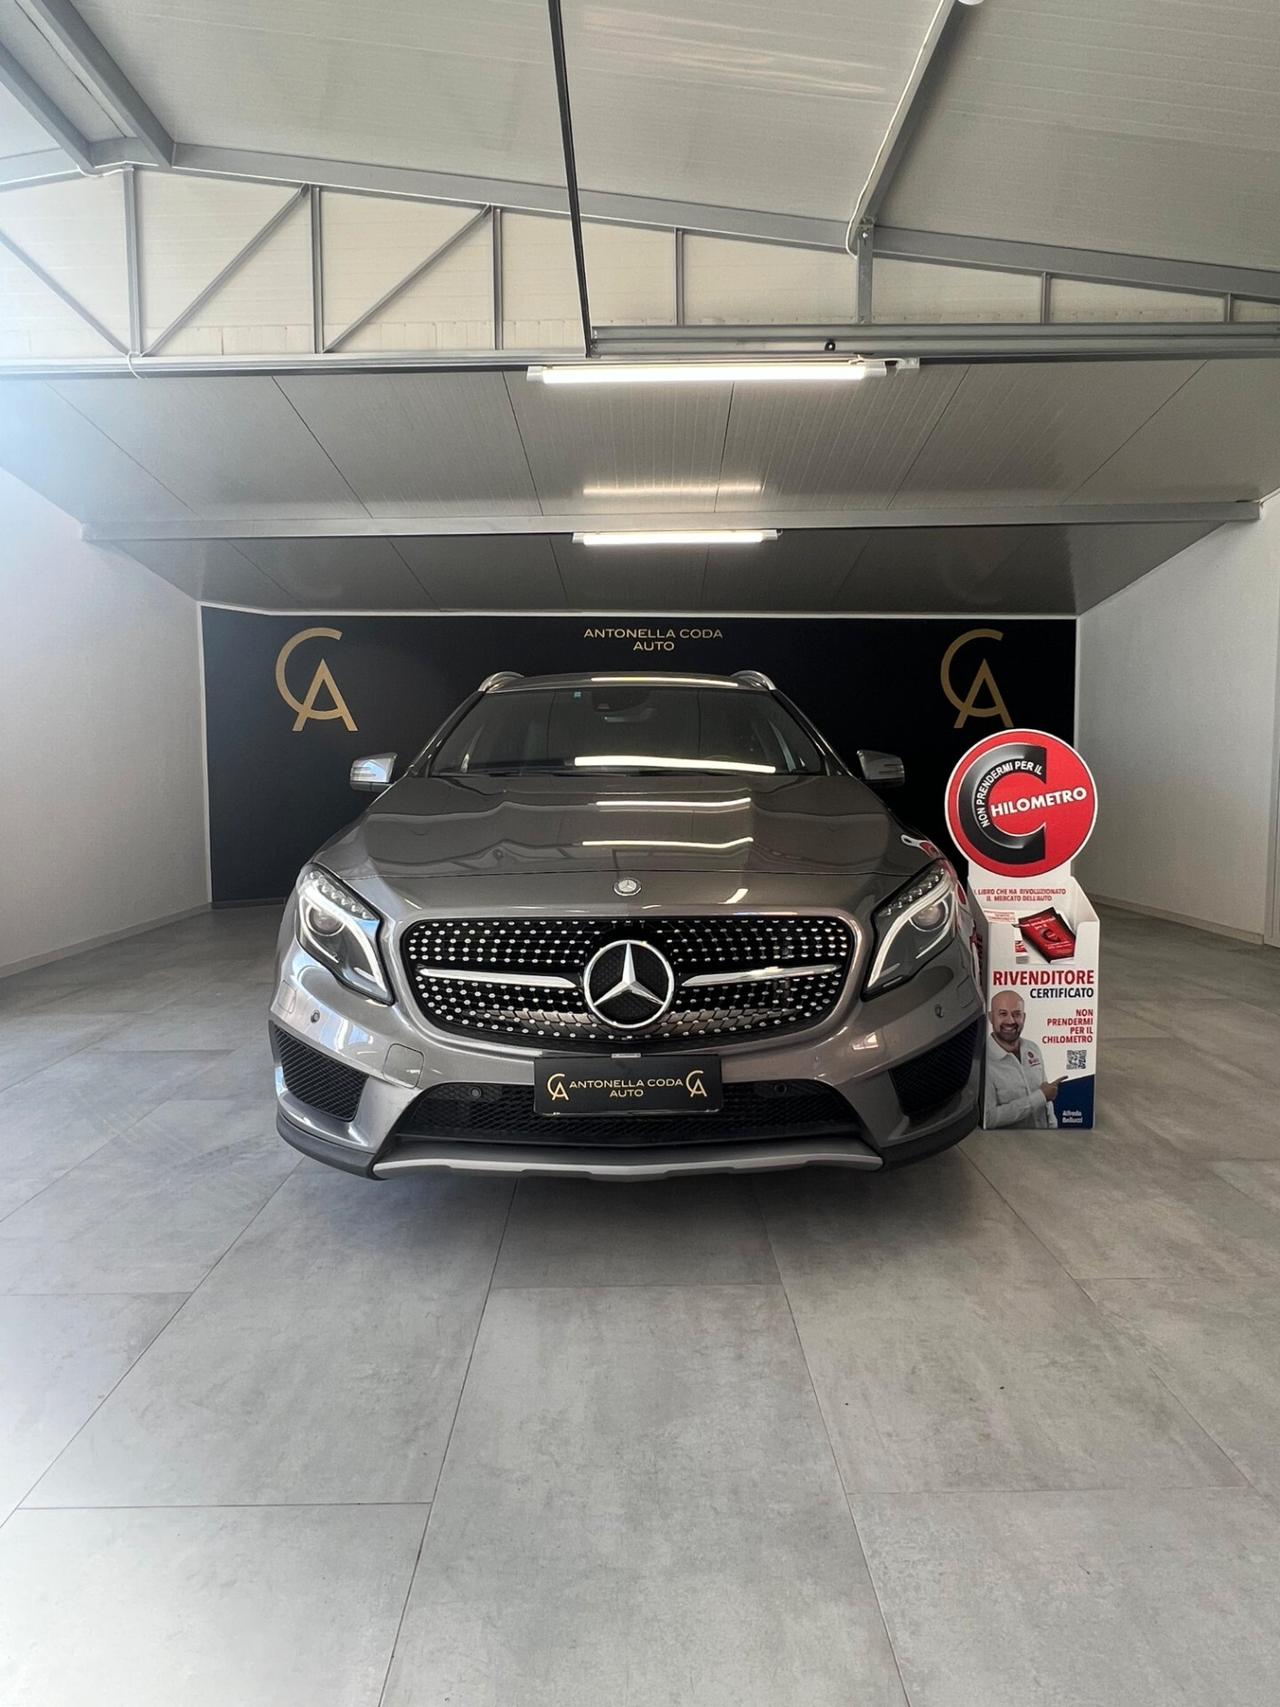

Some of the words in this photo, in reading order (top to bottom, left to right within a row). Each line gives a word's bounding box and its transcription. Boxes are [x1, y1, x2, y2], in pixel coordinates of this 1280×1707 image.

[583, 628, 676, 639] ANTONELLA
[679, 628, 723, 639] CODA
[632, 641, 675, 651] AUTO
[1014, 760, 1035, 771] PER
[1034, 764, 1043, 776] IL
[976, 762, 1014, 806] PRENDERMI
[976, 807, 990, 828] NON
[996, 888, 1007, 896] CHE
[993, 970, 1095, 986] RIVENDITORE
[1030, 987, 1094, 999] CERTIFICATO
[1076, 1008, 1094, 1017] NON
[1046, 1017, 1094, 1026] PRENDERMI
[1070, 1026, 1085, 1035] PER
[1086, 1026, 1093, 1034] IL
[1042, 1035, 1093, 1044] CHILOMETRO
[569, 1079, 645, 1088] ANTONELLA
[647, 1078, 684, 1087] CODA
[609, 1089, 644, 1097] AUTO
